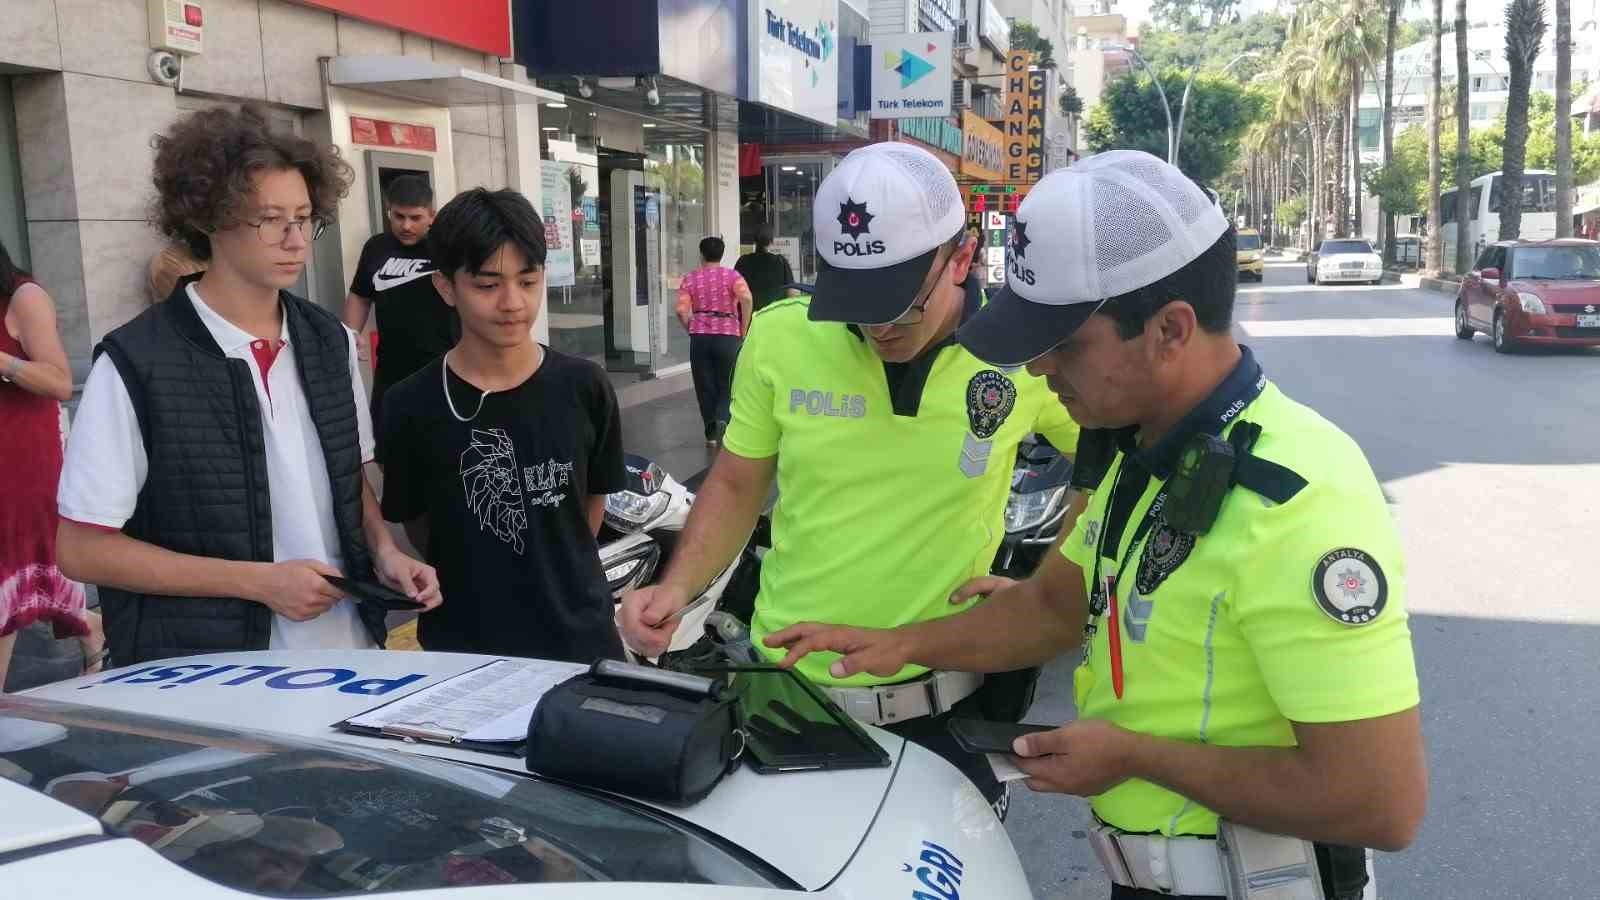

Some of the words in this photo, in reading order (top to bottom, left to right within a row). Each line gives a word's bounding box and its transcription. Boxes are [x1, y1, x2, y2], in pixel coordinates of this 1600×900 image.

[878, 99, 898, 109] Türk
[902, 98, 944, 108] Telekom
[1009, 55, 1024, 179] CHANGE
[1029, 76, 1042, 183] CHANGE
[380, 257, 428, 276] NIKE
[1323, 549, 1366, 567] ANTALYA
